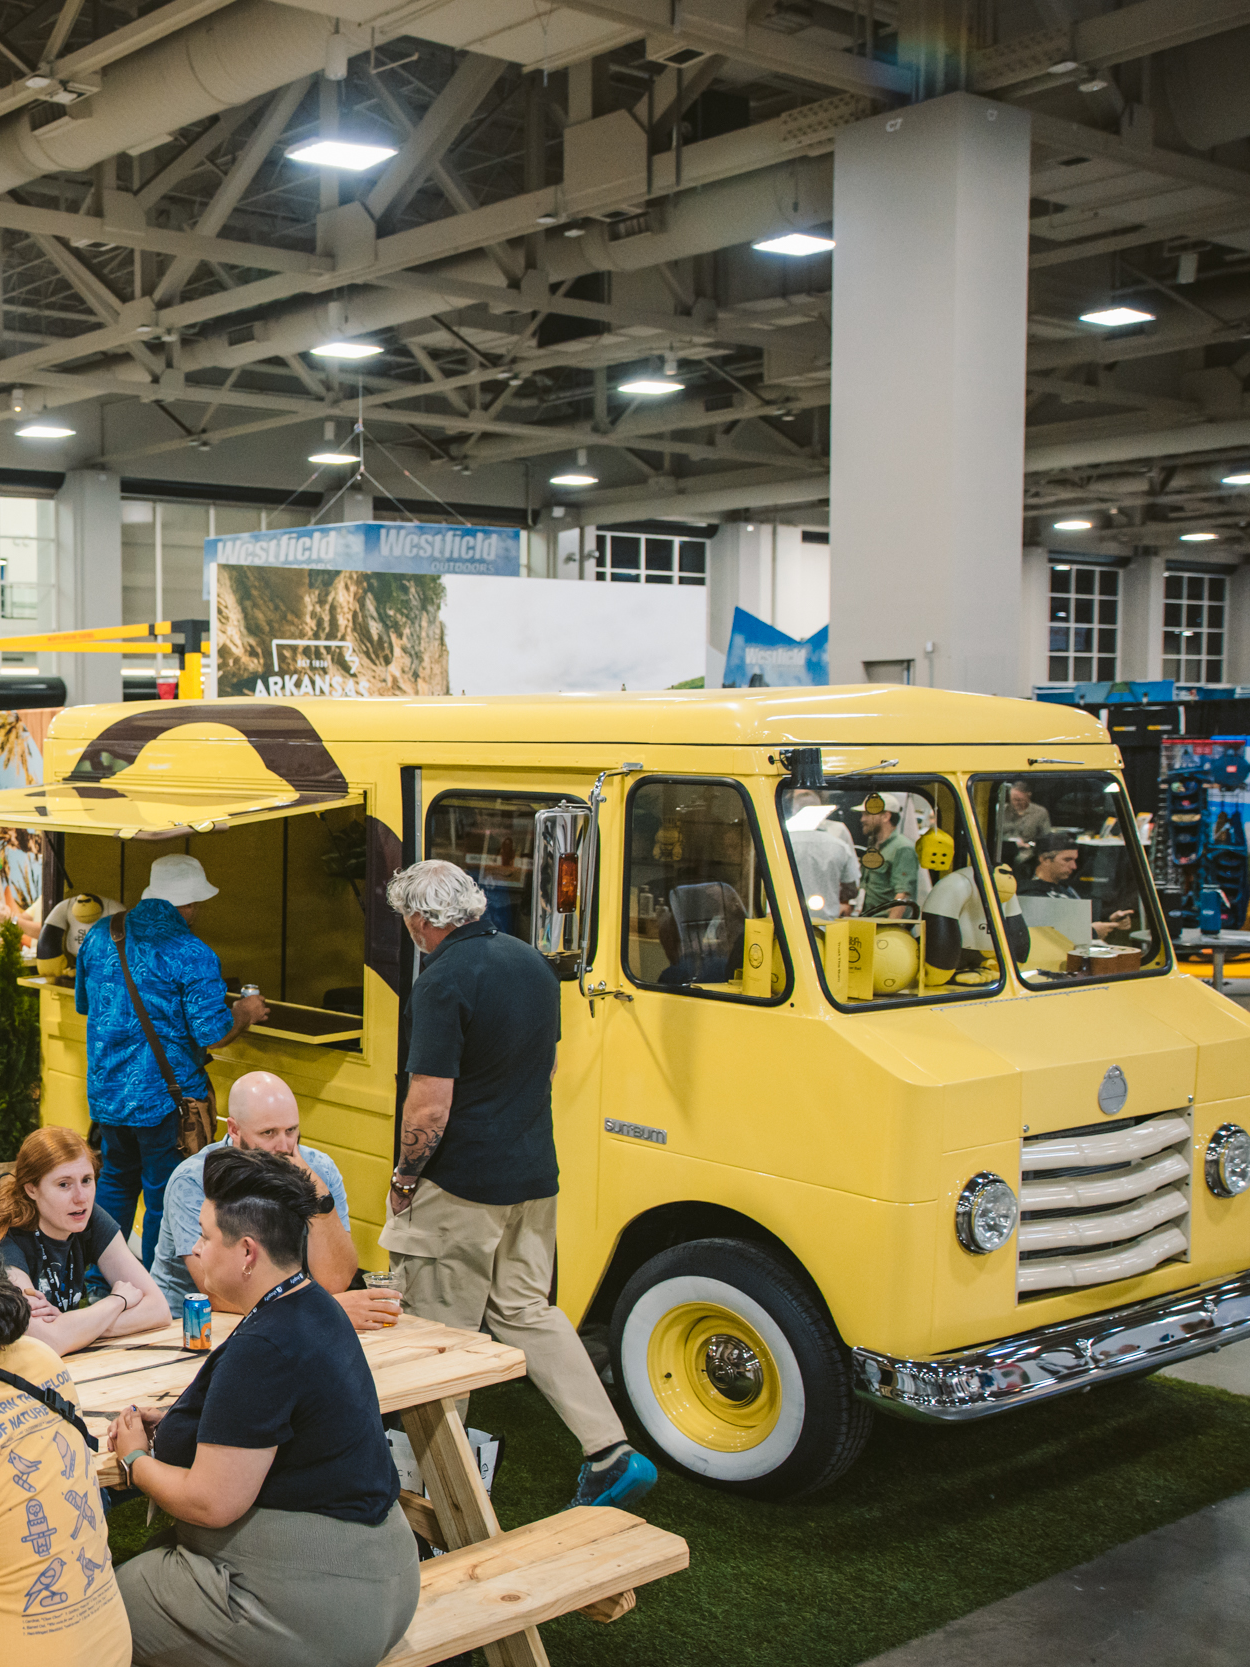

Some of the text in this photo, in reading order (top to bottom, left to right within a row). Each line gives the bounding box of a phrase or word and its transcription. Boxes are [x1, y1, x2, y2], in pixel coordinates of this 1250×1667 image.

[217, 530, 336, 564] Westfield
[379, 528, 497, 560] Westfield
[254, 673, 370, 697] ARKANSAS
[8, 1404, 50, 1431] NATURE
